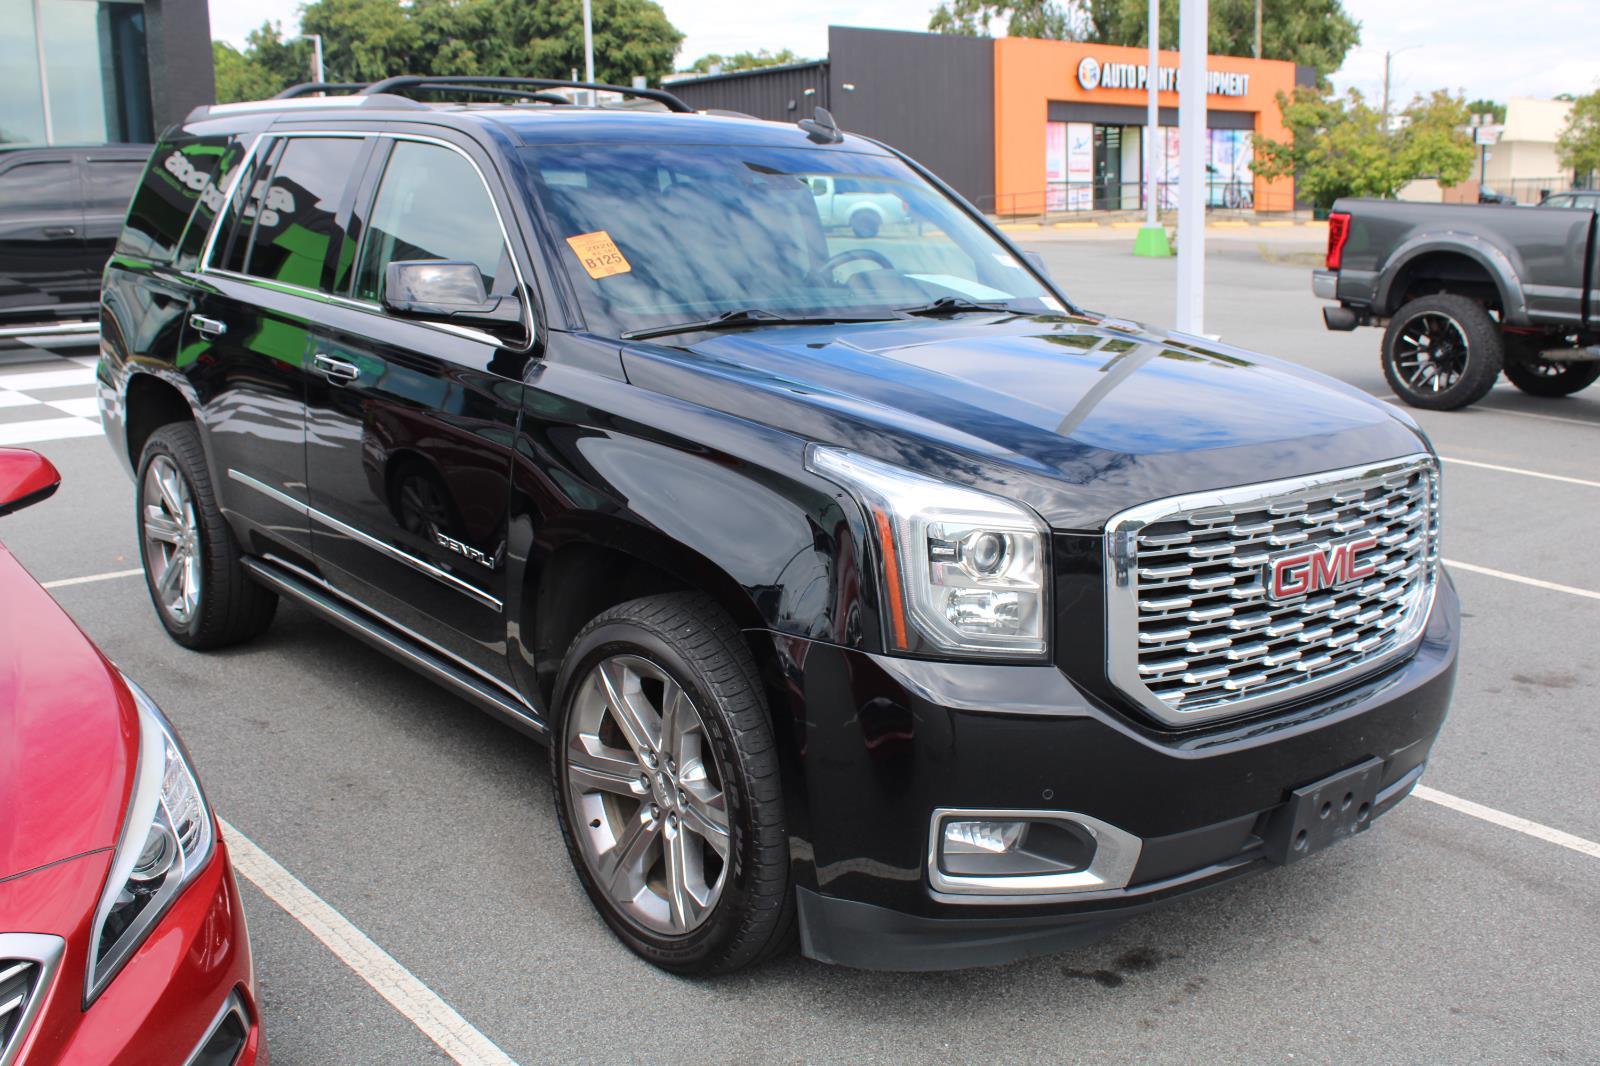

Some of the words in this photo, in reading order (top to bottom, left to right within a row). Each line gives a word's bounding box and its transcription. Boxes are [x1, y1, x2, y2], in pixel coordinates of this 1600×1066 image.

[1101, 63, 1136, 89] AUTO
[1137, 65, 1176, 91] PNT
[1205, 71, 1249, 96] IPMENT
[585, 252, 623, 269] B125
[1271, 535, 1377, 600] GMC
